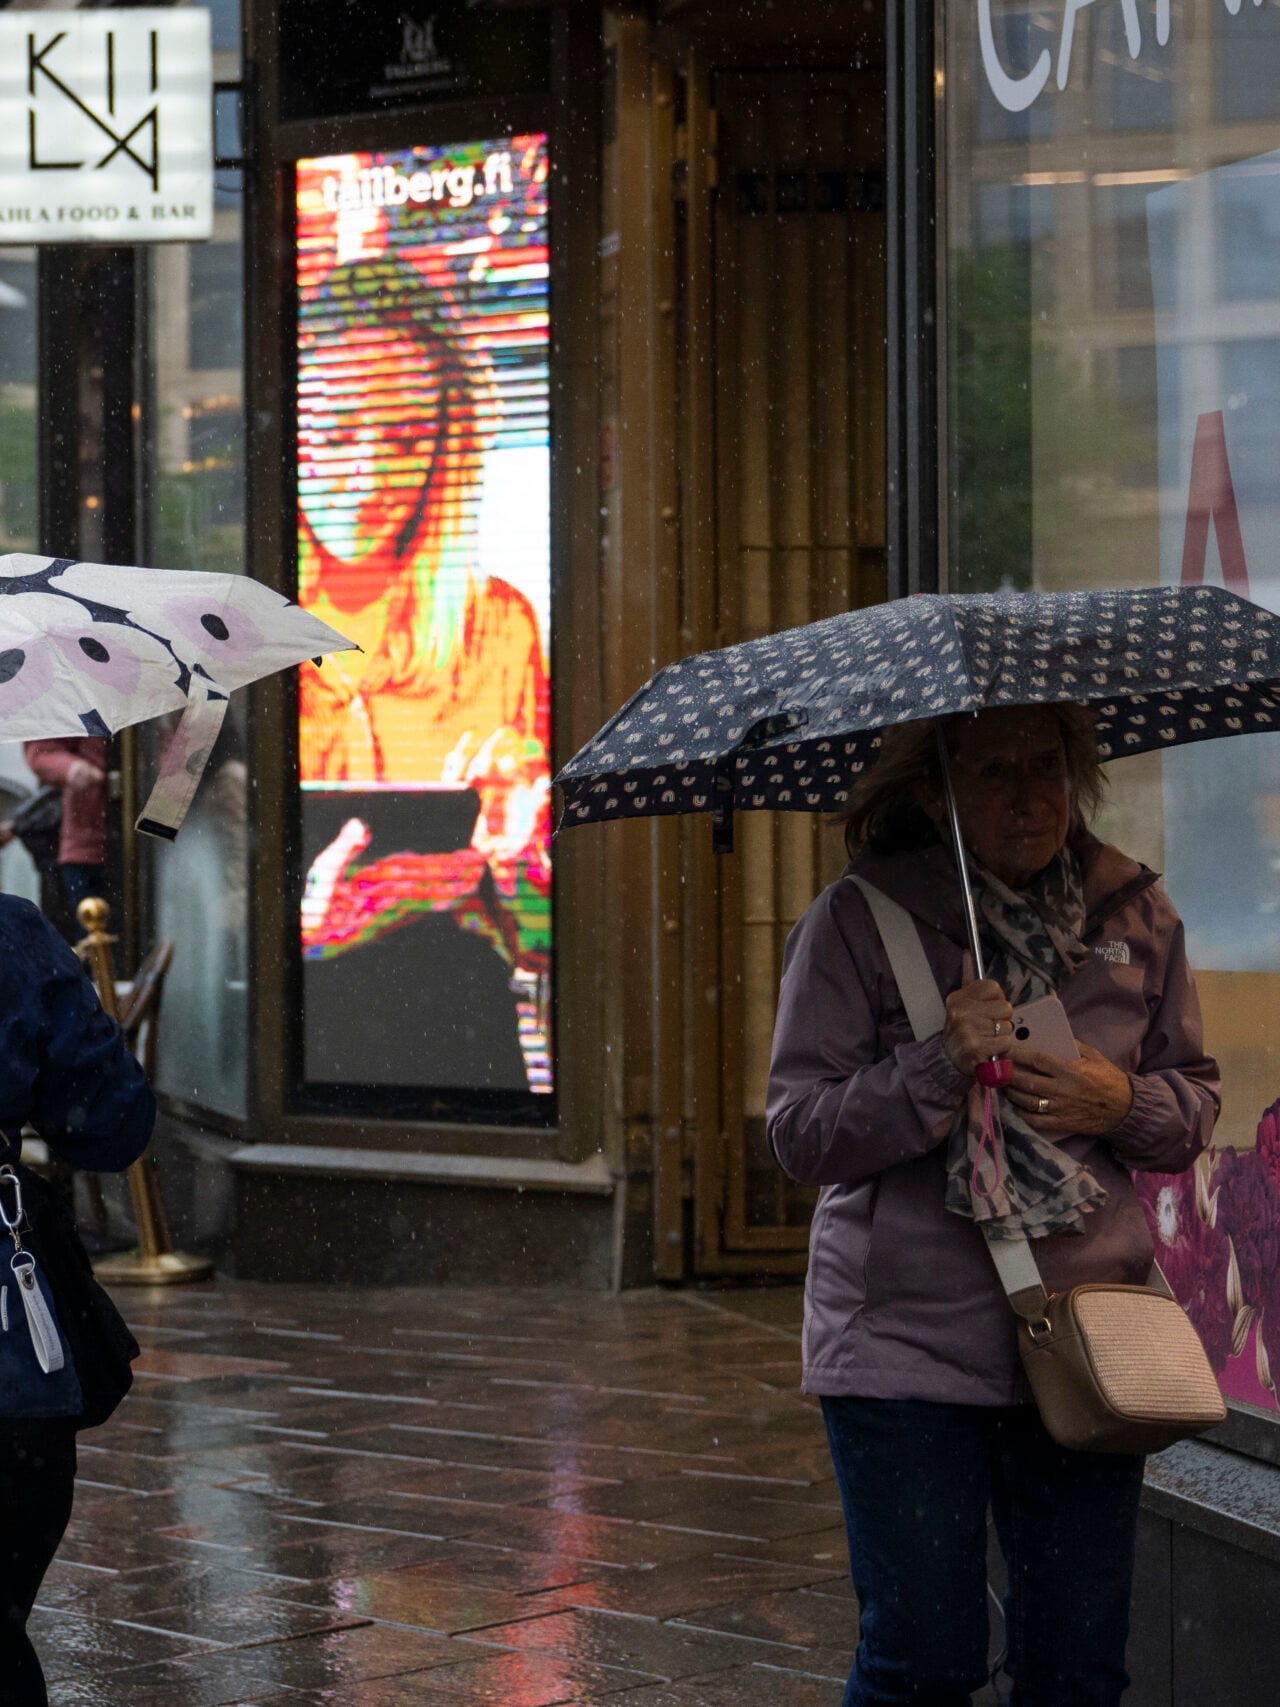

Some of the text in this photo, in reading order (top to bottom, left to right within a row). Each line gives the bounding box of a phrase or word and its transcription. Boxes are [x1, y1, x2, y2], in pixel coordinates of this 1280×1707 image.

[58, 206, 120, 222] FOOD
[128, 206, 140, 220] &
[151, 204, 197, 220] BAR
[1095, 947, 1121, 955] NORTH
[1104, 954, 1121, 963] FACE
